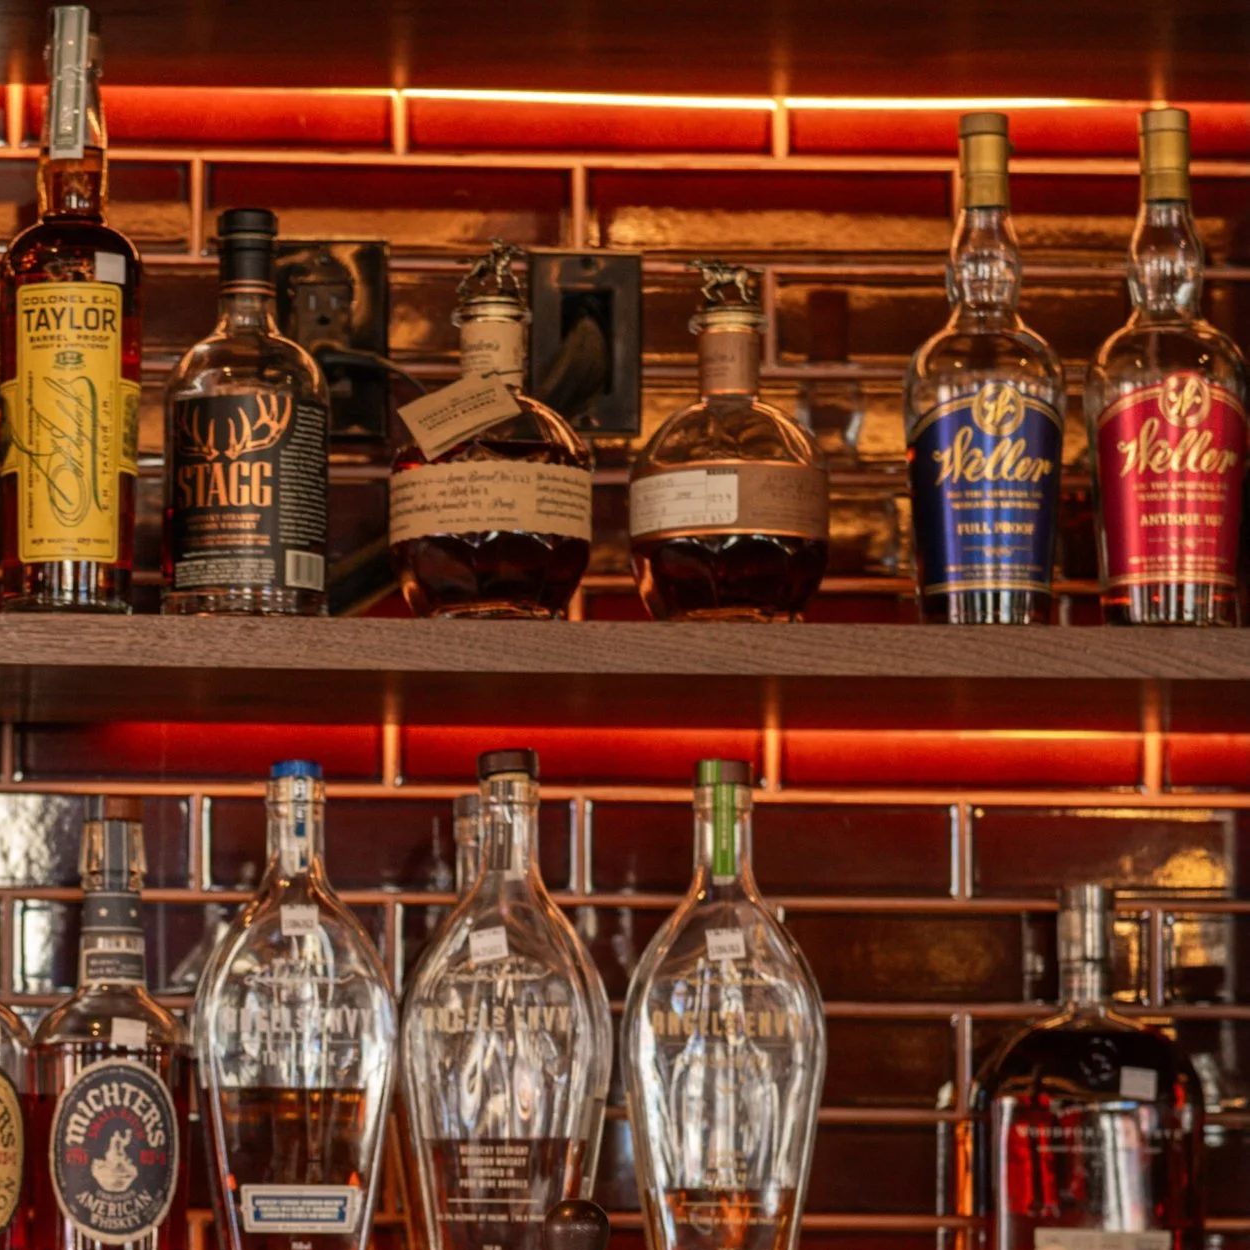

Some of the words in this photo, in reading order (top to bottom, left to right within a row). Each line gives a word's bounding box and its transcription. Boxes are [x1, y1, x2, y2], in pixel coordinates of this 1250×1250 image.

[22, 295, 86, 306] COLONEL
[22, 307, 117, 333] TAYLOR
[102, 425, 110, 475] TAYLOR
[932, 426, 1053, 487] Weller
[1117, 418, 1238, 477] Weller
[177, 461, 273, 508] STAGG
[957, 522, 991, 536] FULL
[513, 1005, 571, 1032] ENVY
[65, 1082, 166, 1148] MICHTER'S
[76, 1189, 154, 1218] AMERICAN
